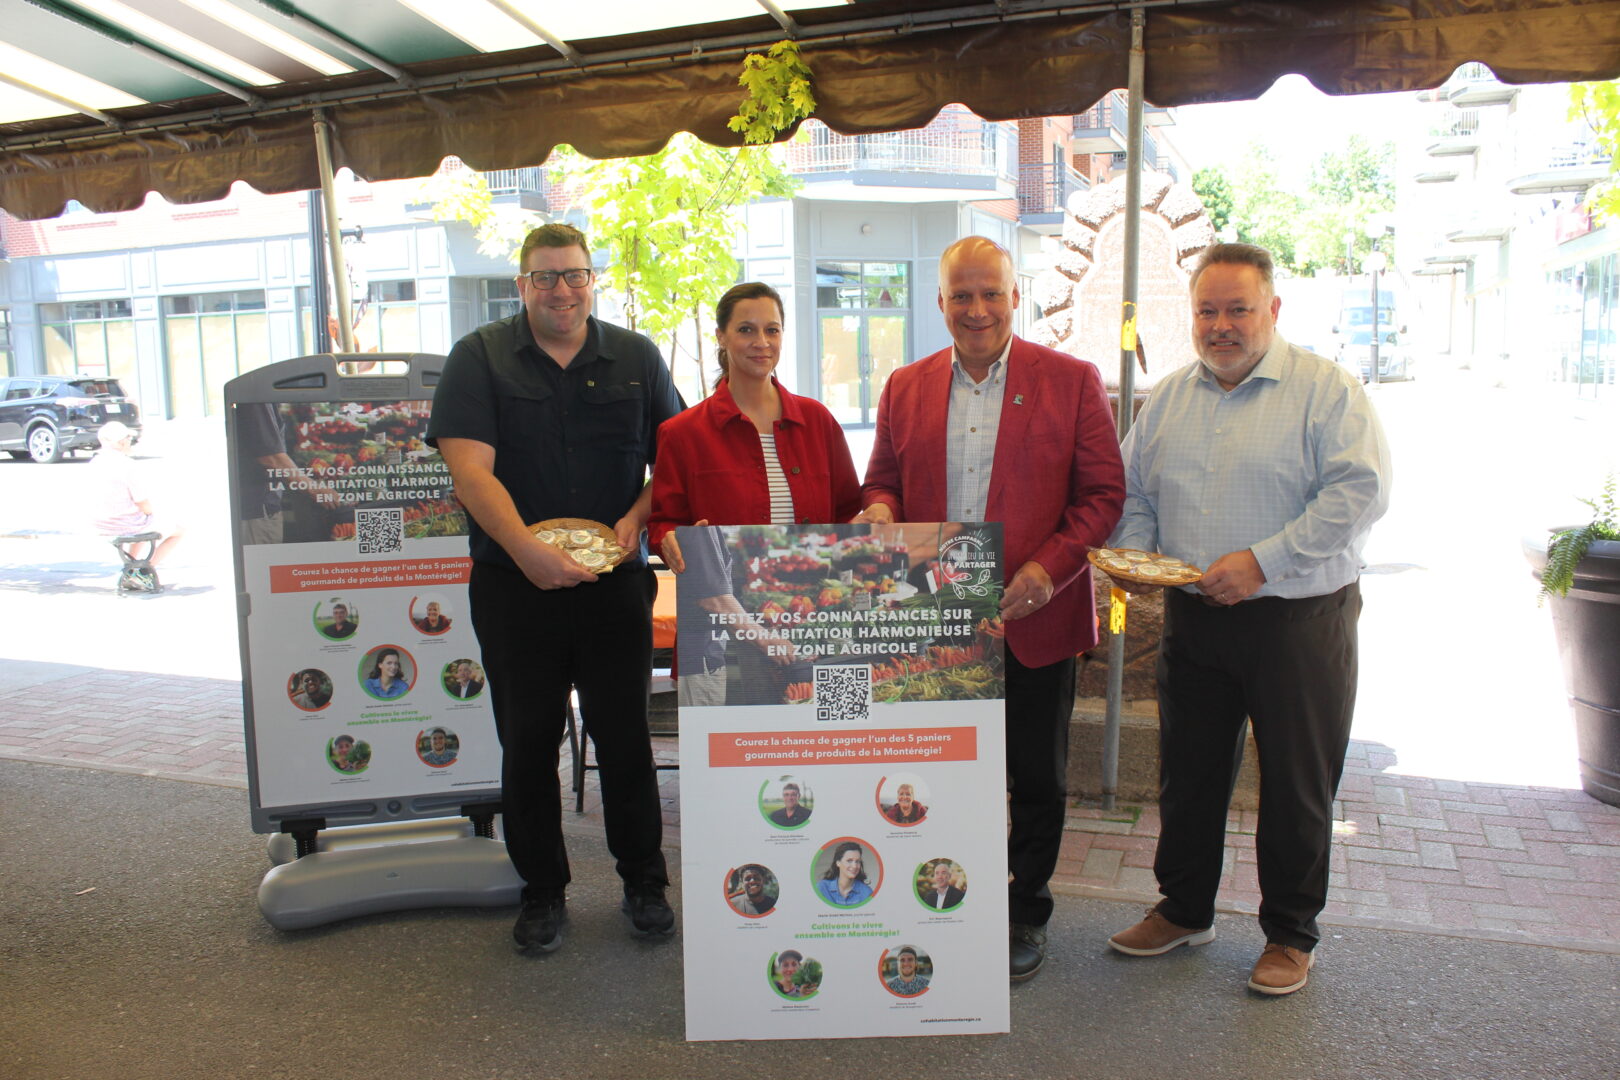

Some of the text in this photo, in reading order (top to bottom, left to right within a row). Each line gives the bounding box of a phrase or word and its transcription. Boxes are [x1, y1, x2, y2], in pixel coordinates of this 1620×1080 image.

[267, 463, 449, 478] TESTEZ VOS CONNAISSANCE
[269, 477, 453, 491] LA COHABITATION HARMONI
[316, 490, 440, 502] EN ZONE AGRICOLE
[955, 536, 983, 546] CAMPAGNE
[292, 568, 320, 576] Courez
[360, 565, 370, 573] de
[441, 562, 469, 570] paniers
[300, 578, 346, 588] gourmands
[360, 575, 393, 584] produits
[709, 609, 972, 624] TESTEZ VOS CONNAISSANCES SUR
[711, 625, 971, 640] LA COHABITATION HARMONIEUSE
[767, 643, 917, 656] EN ZONE AGRICOLE
[735, 738, 769, 747] Courez
[771, 737, 779, 745] la
[782, 737, 815, 745] chance
[818, 736, 830, 745] de
[832, 736, 866, 746] gagner
[889, 734, 906, 743] des
[908, 734, 914, 742] 5
[916, 733, 952, 744] paniers
[745, 746, 942, 761] gourmands de produits de la Montérégie!
[811, 922, 850, 930] Cultivons
[795, 931, 835, 939] ensemble
